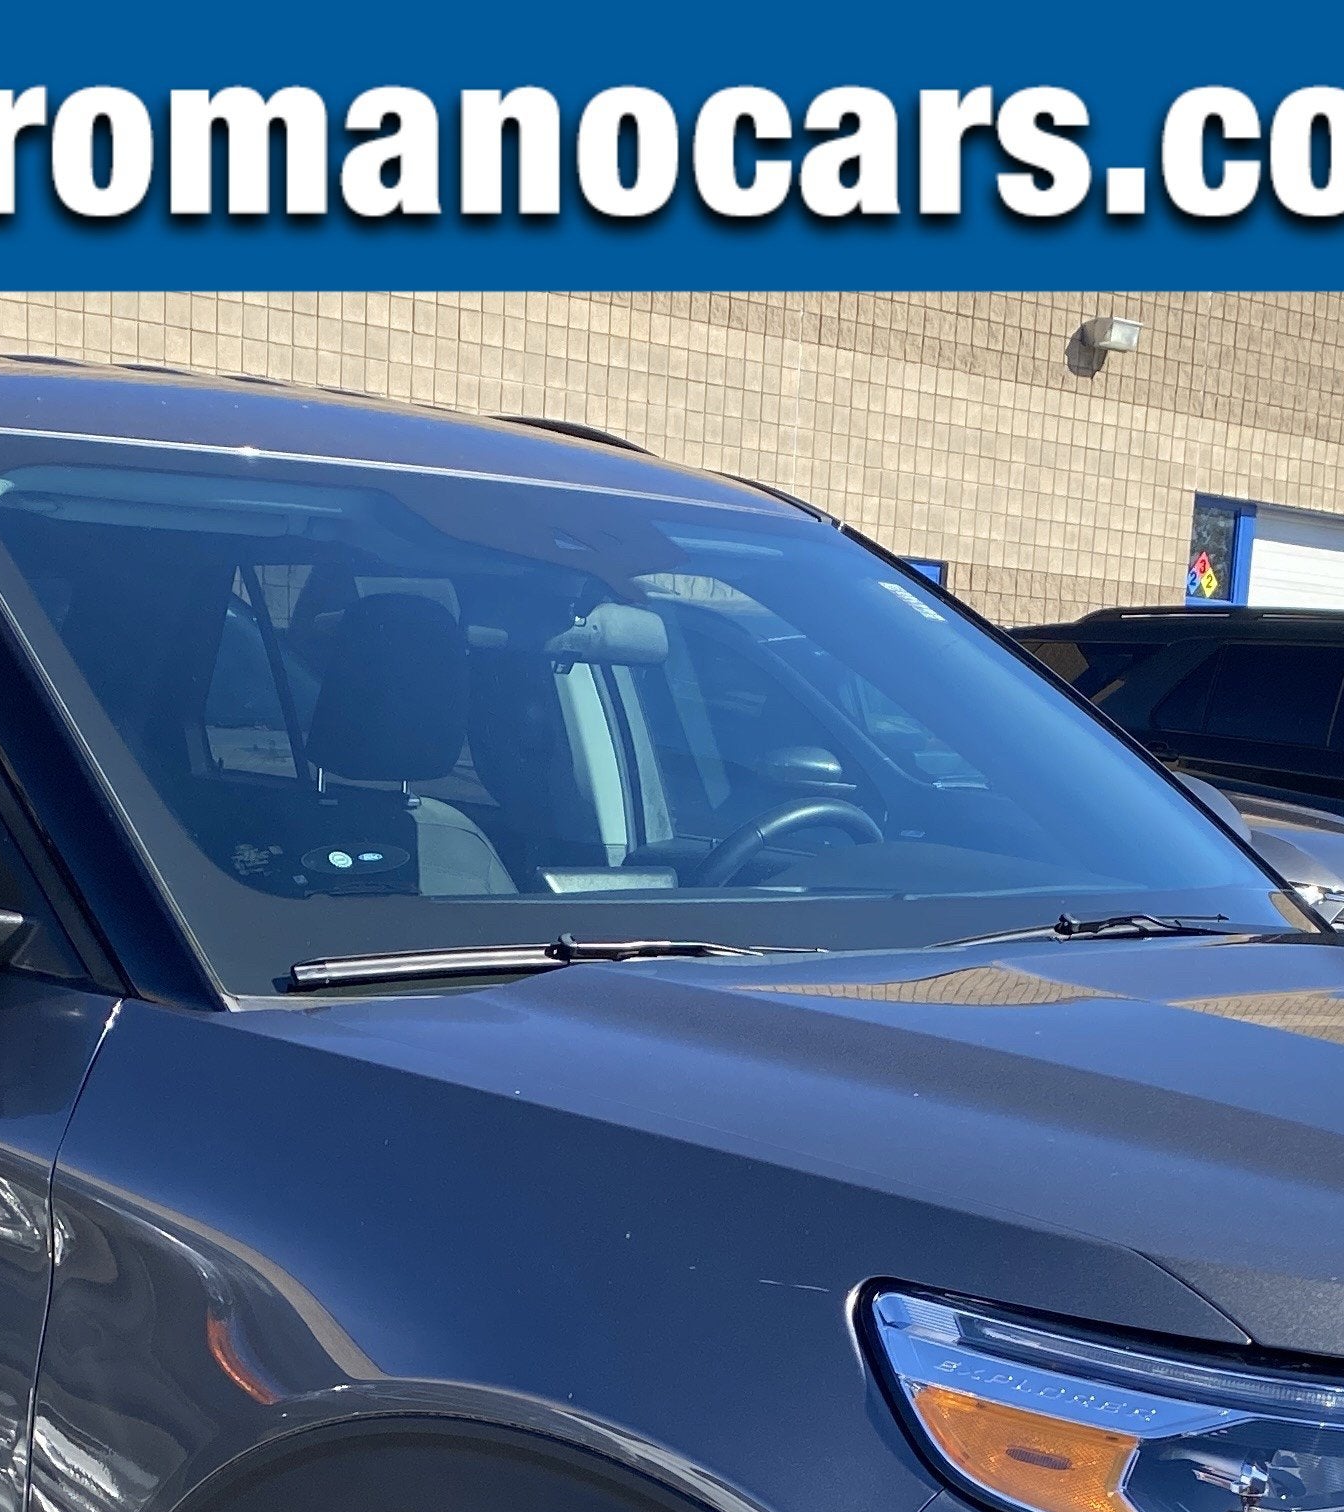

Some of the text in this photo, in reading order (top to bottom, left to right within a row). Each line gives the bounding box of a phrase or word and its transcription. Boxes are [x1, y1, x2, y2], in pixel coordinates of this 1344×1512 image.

[1199, 559, 1206, 574] 3
[1189, 571, 1197, 586] 2
[1205, 573, 1213, 589] 2
[934, 1359, 1157, 1423] EXPLORER
